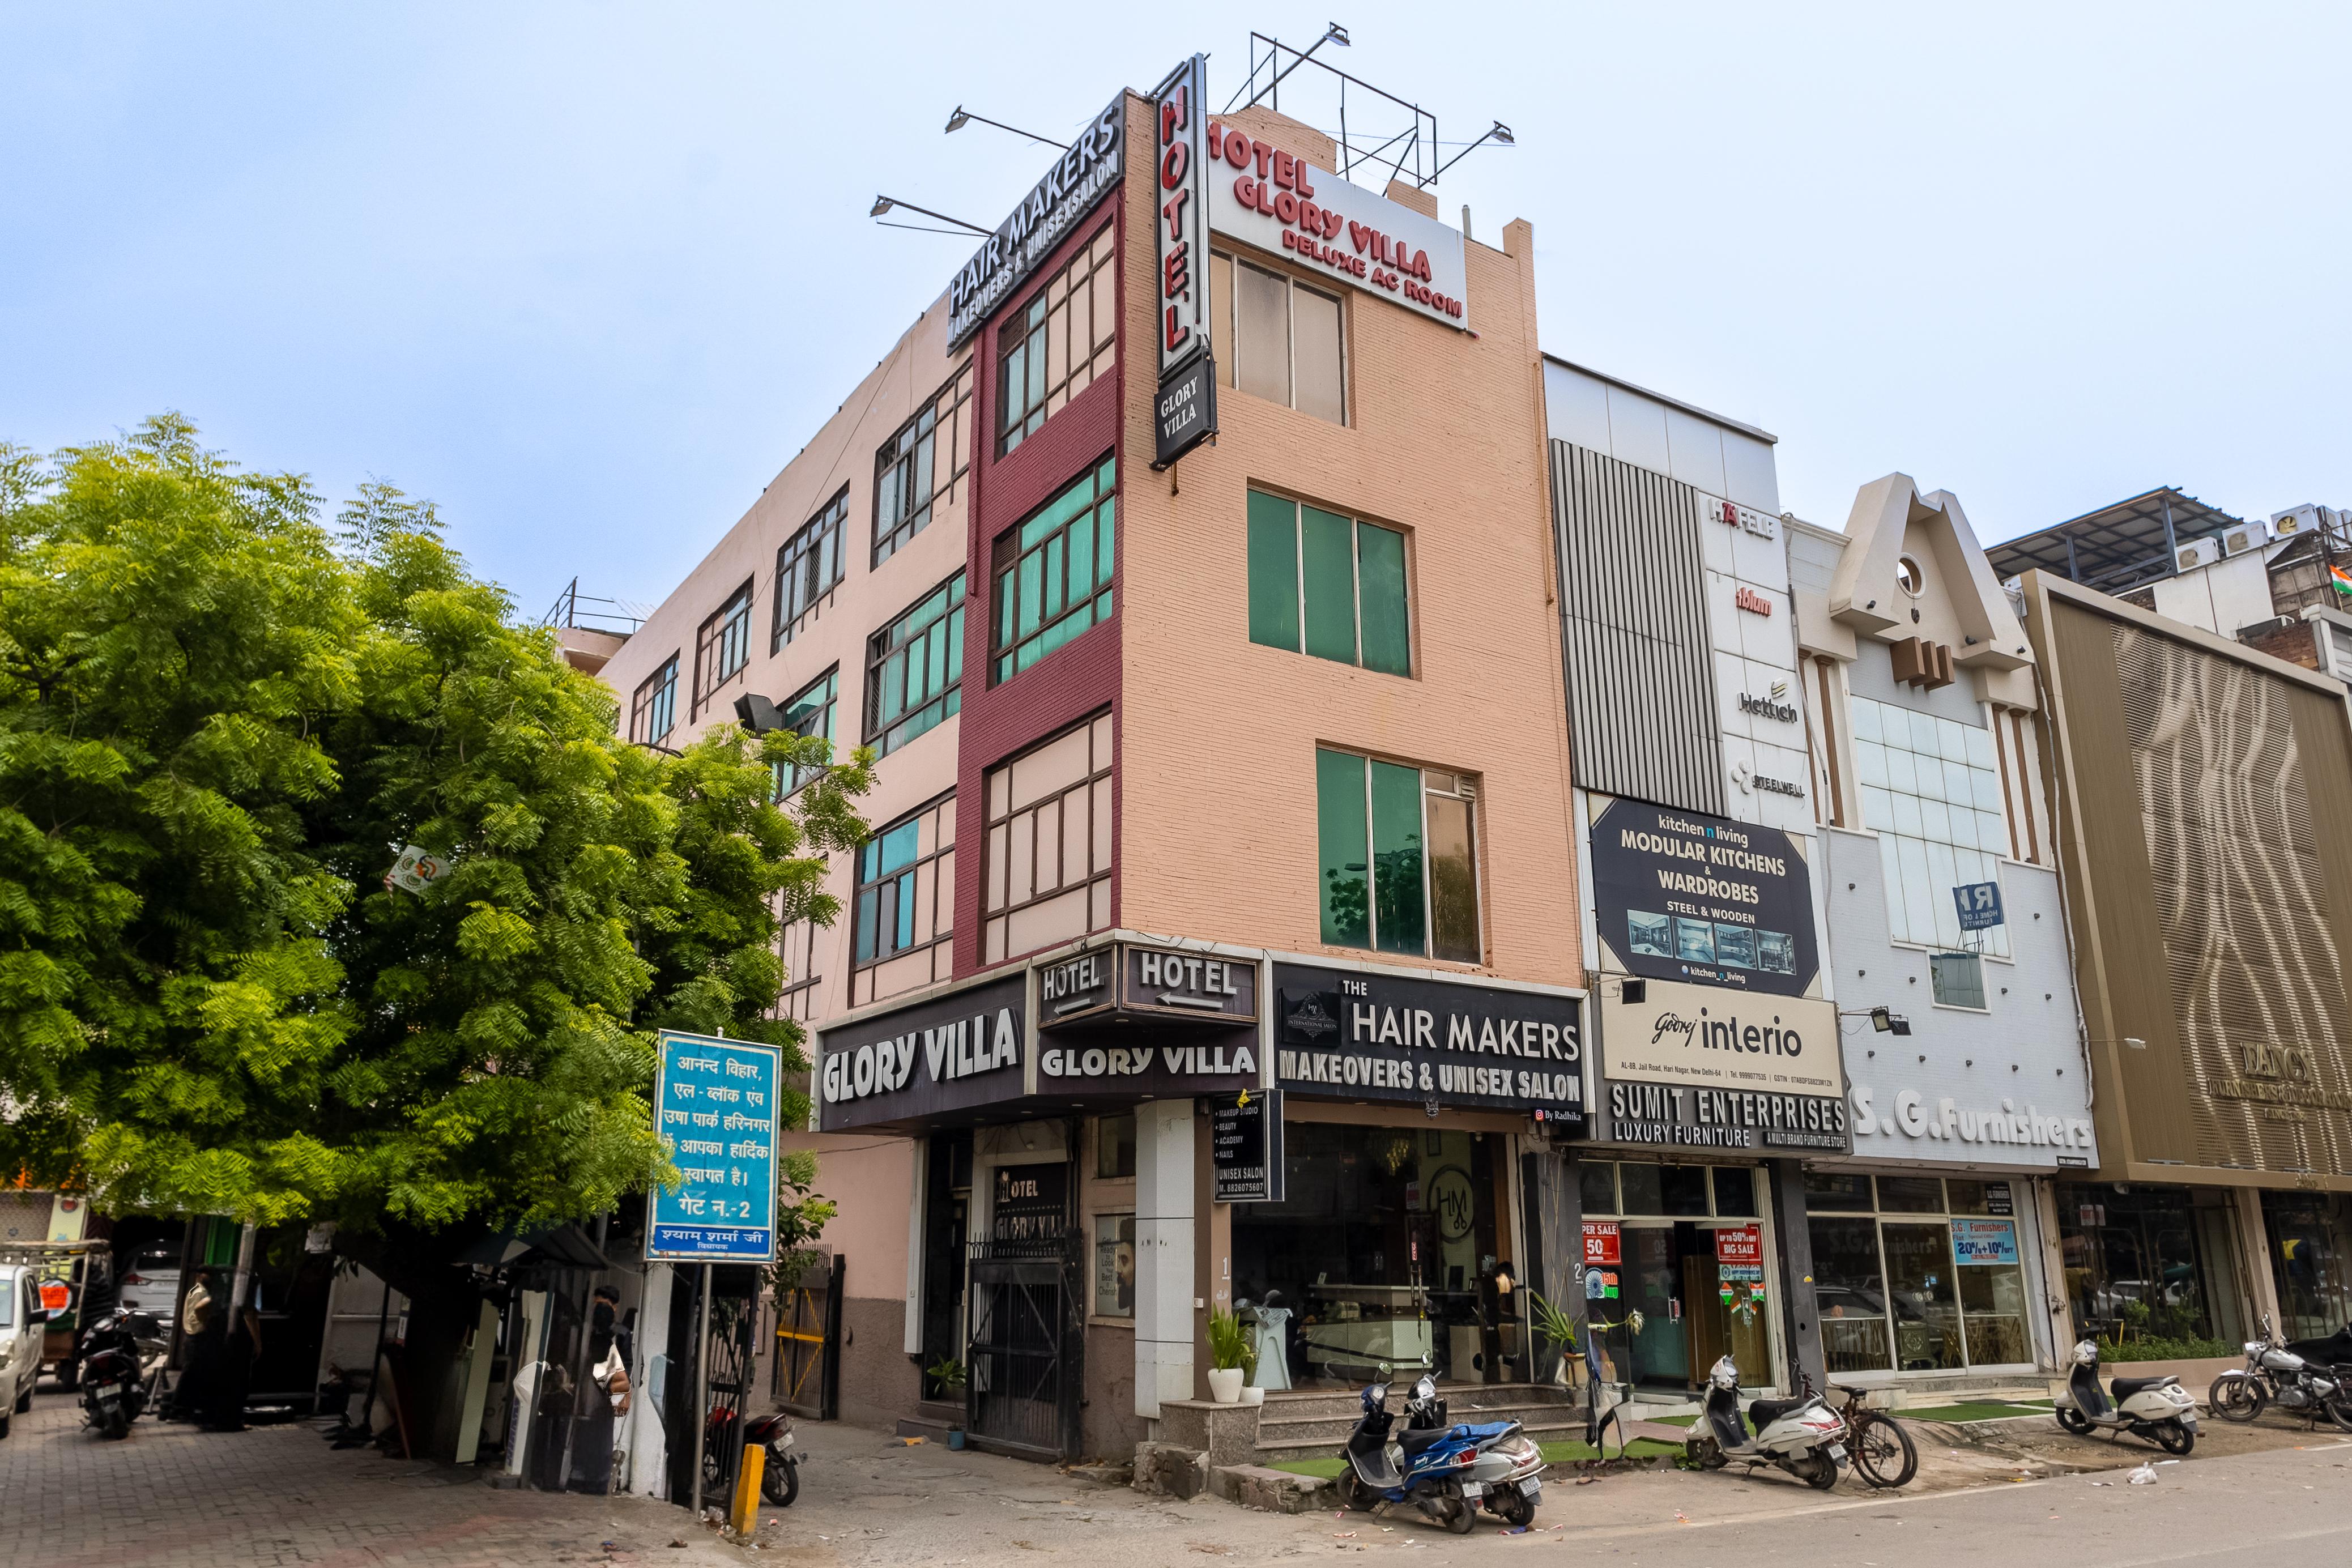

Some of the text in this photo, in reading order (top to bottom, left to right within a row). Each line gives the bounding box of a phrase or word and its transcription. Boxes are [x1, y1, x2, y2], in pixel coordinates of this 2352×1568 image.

[1208, 121, 1314, 199] HOTEL
[950, 105, 1118, 318] HAIR MAKERS
[1161, 85, 1189, 352] HOTEL
[1233, 175, 1432, 283] GLORY VILLA
[1282, 228, 1462, 319] DELUXE AC ROOM
[947, 262, 1014, 347] MAKEOVERS
[1015, 250, 1025, 274] &
[1161, 376, 1198, 419] GLORY
[1164, 402, 1197, 440] VILLA
[1738, 587, 1772, 617] blum
[1737, 692, 1797, 723] Hettich
[1752, 774, 1805, 798] STEELWELL
[1658, 815, 1748, 848] kitchen n living
[1621, 829, 1786, 877] MODULAR KITCHENS
[1705, 866, 1711, 875] &
[1658, 870, 1759, 904] WARDROBES
[1667, 901, 1756, 924] STEEL & WOODEN
[1043, 956, 1104, 1000] HOTEL
[1141, 953, 1237, 995] HOTEL
[1690, 966, 1746, 984] kitchen_n_living
[1343, 979, 1367, 996] THE
[1288, 1019, 1322, 1028] INTERNATIONAL
[1352, 1003, 1579, 1061] HAIR MAKERS
[1651, 1007, 1802, 1057] Godrej interio
[823, 1008, 1019, 1103] GLORY VILLA
[1042, 1046, 1256, 1077] GLORY VILLA
[2240, 1042, 2313, 1081] FANCY
[677, 1055, 762, 1081] आनन्द विहार,
[1279, 1050, 1579, 1102] MAKEOVERS & UNISEX SALON
[1648, 1064, 1663, 1072] Road,
[1674, 1066, 1690, 1075] Nagar,
[1739, 1072, 1766, 1080] 9999077535
[674, 1083, 694, 1099] एल
[707, 1086, 739, 1102] ब्लॉक
[664, 1109, 688, 1126] उषा
[692, 1110, 718, 1128] पार्क
[1219, 1106, 1258, 1117] MAKEUP STUDIO
[1545, 1110, 1582, 1122] By Radhika
[1612, 1083, 1845, 1131] SUMIT ENTERPRISES
[1219, 1122, 1236, 1131] BEAUTY
[1615, 1122, 1750, 1147] LUXURY FURNITURE
[680, 1139, 722, 1156] आपका
[730, 1140, 769, 1160] हार्दिक
[1219, 1136, 1243, 1144] ACADEMY
[1767, 1132, 1846, 1148] A MULTI BRAND FURNITURE STORE
[1219, 1150, 1233, 1158] NAILS
[683, 1167, 725, 1184] स्वागत
[1219, 1167, 1263, 1180] UNISEX SALON
[1227, 1183, 1263, 1192] 8826075607
[679, 1192, 705, 1216] गेट
[661, 1230, 764, 1243] श्याम शर्मा जी
[1597, 1225, 1617, 1235] SALE
[1951, 1223, 2008, 1232] S.G. Furnishers
[1724, 1245, 1754, 1254] BIG SALE
[1223, 1257, 1228, 1275] 1
[1574, 1263, 1582, 1280] 2
[1602, 1272, 1617, 1285] 15th
